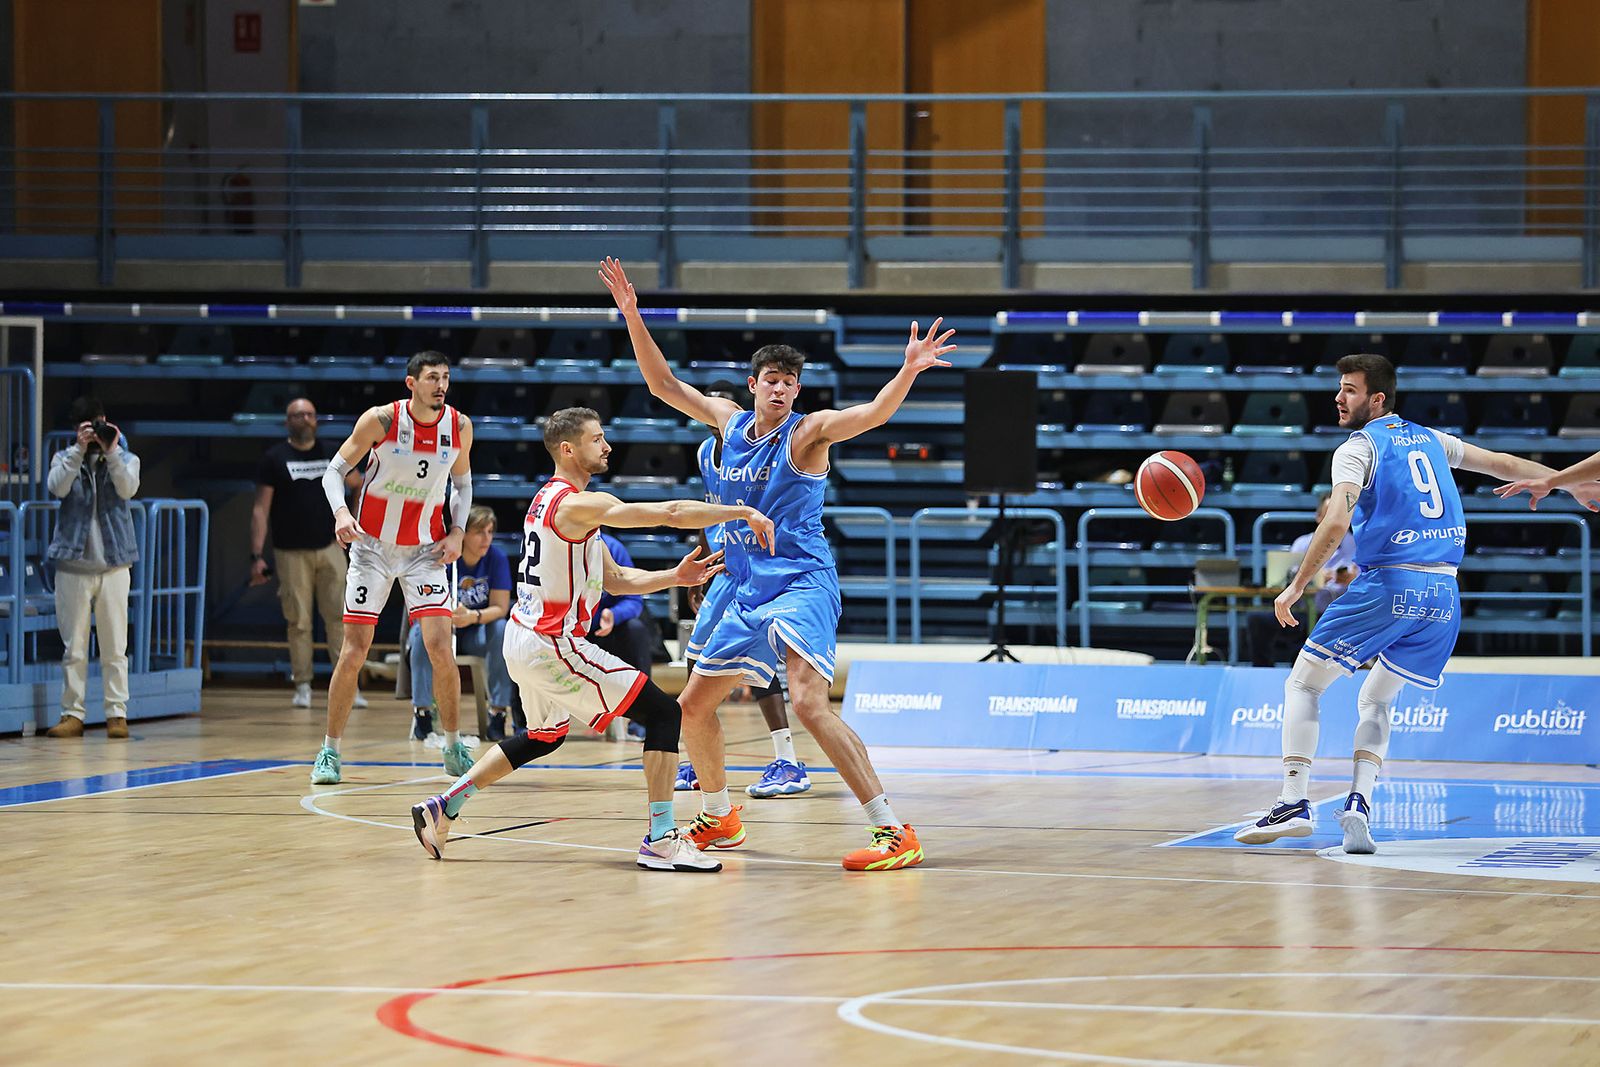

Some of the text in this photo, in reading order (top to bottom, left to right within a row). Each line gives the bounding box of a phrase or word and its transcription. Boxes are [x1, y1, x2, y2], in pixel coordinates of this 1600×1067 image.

[417, 459, 429, 479] 3
[1407, 450, 1444, 519] 9
[355, 586, 368, 605] 3
[1393, 604, 1452, 621] GESTIA
[855, 692, 943, 711] TRANSROMÁN
[988, 695, 1078, 713] TRANSROMÁN
[1116, 698, 1207, 716] TRANSROMÁN
[1493, 709, 1587, 732] publibit
